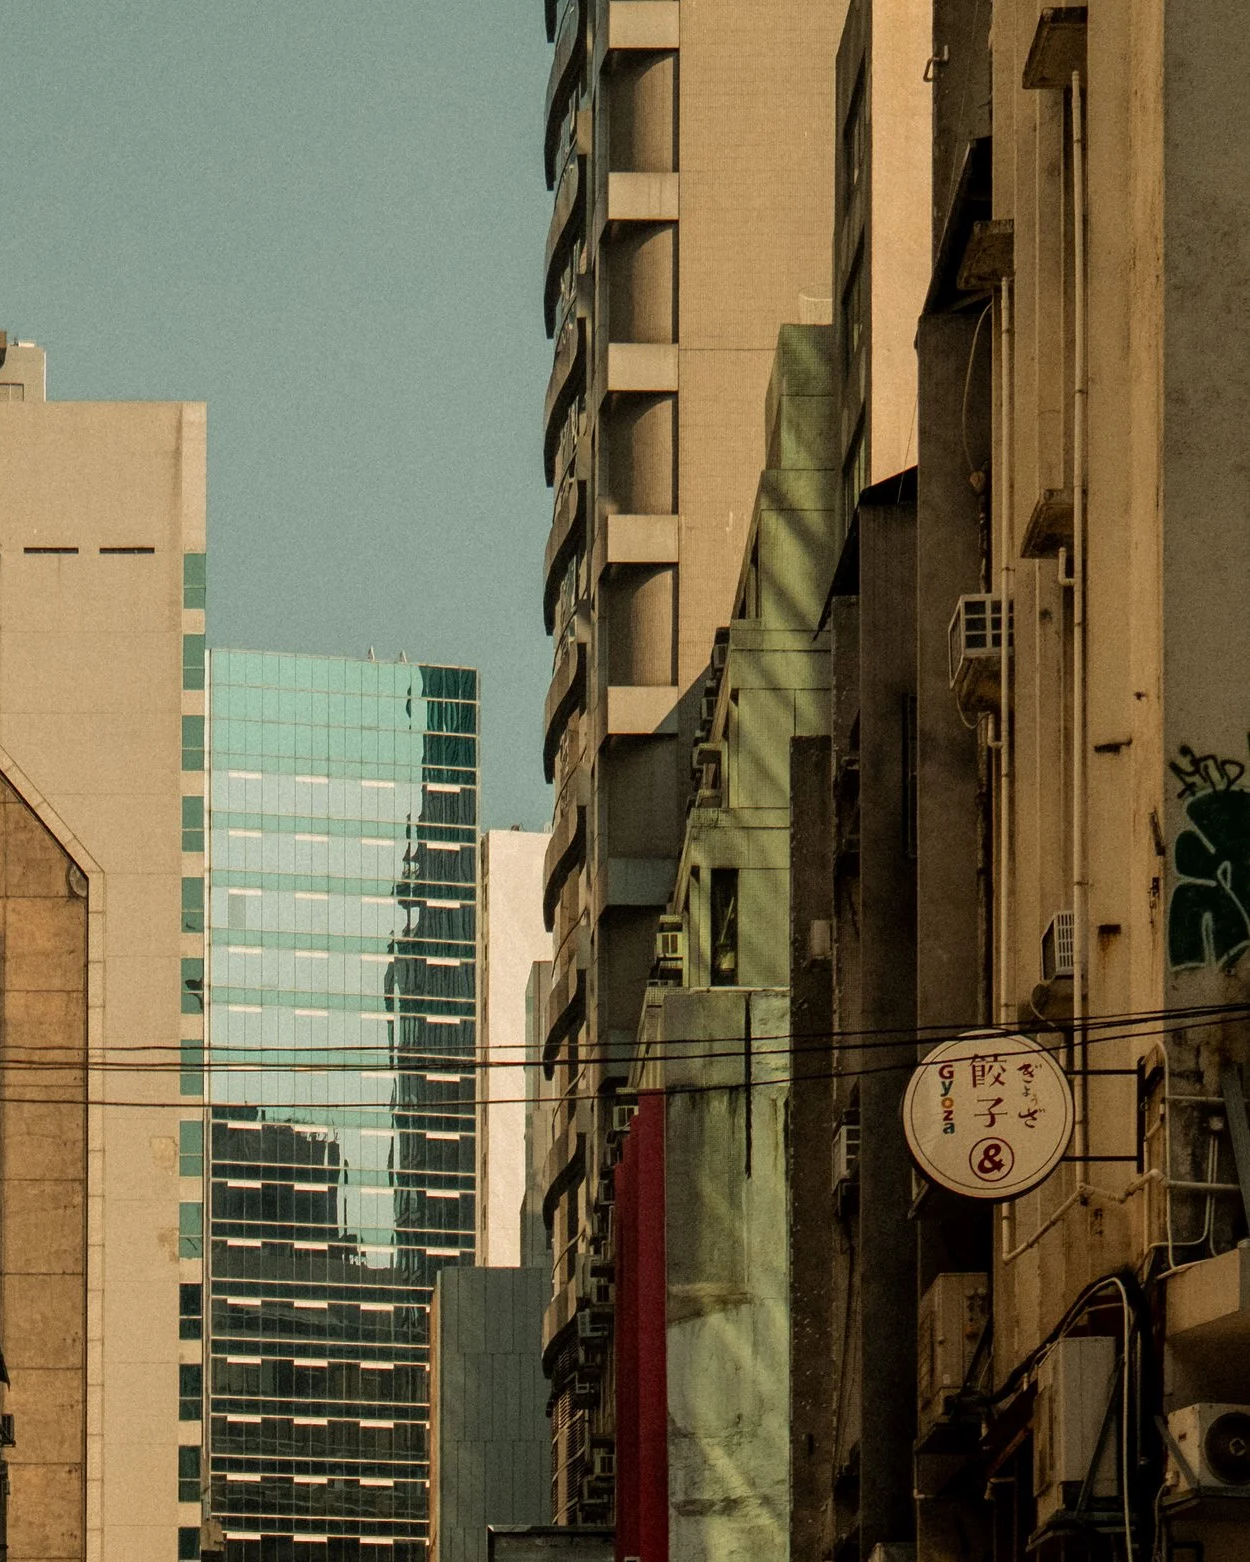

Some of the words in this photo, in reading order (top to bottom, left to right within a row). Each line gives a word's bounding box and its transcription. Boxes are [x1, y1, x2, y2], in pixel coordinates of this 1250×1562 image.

[938, 1064, 956, 1134] Gyoza
[969, 1054, 1008, 1128] 餃子
[1017, 1062, 1046, 1129] ぎょうざ
